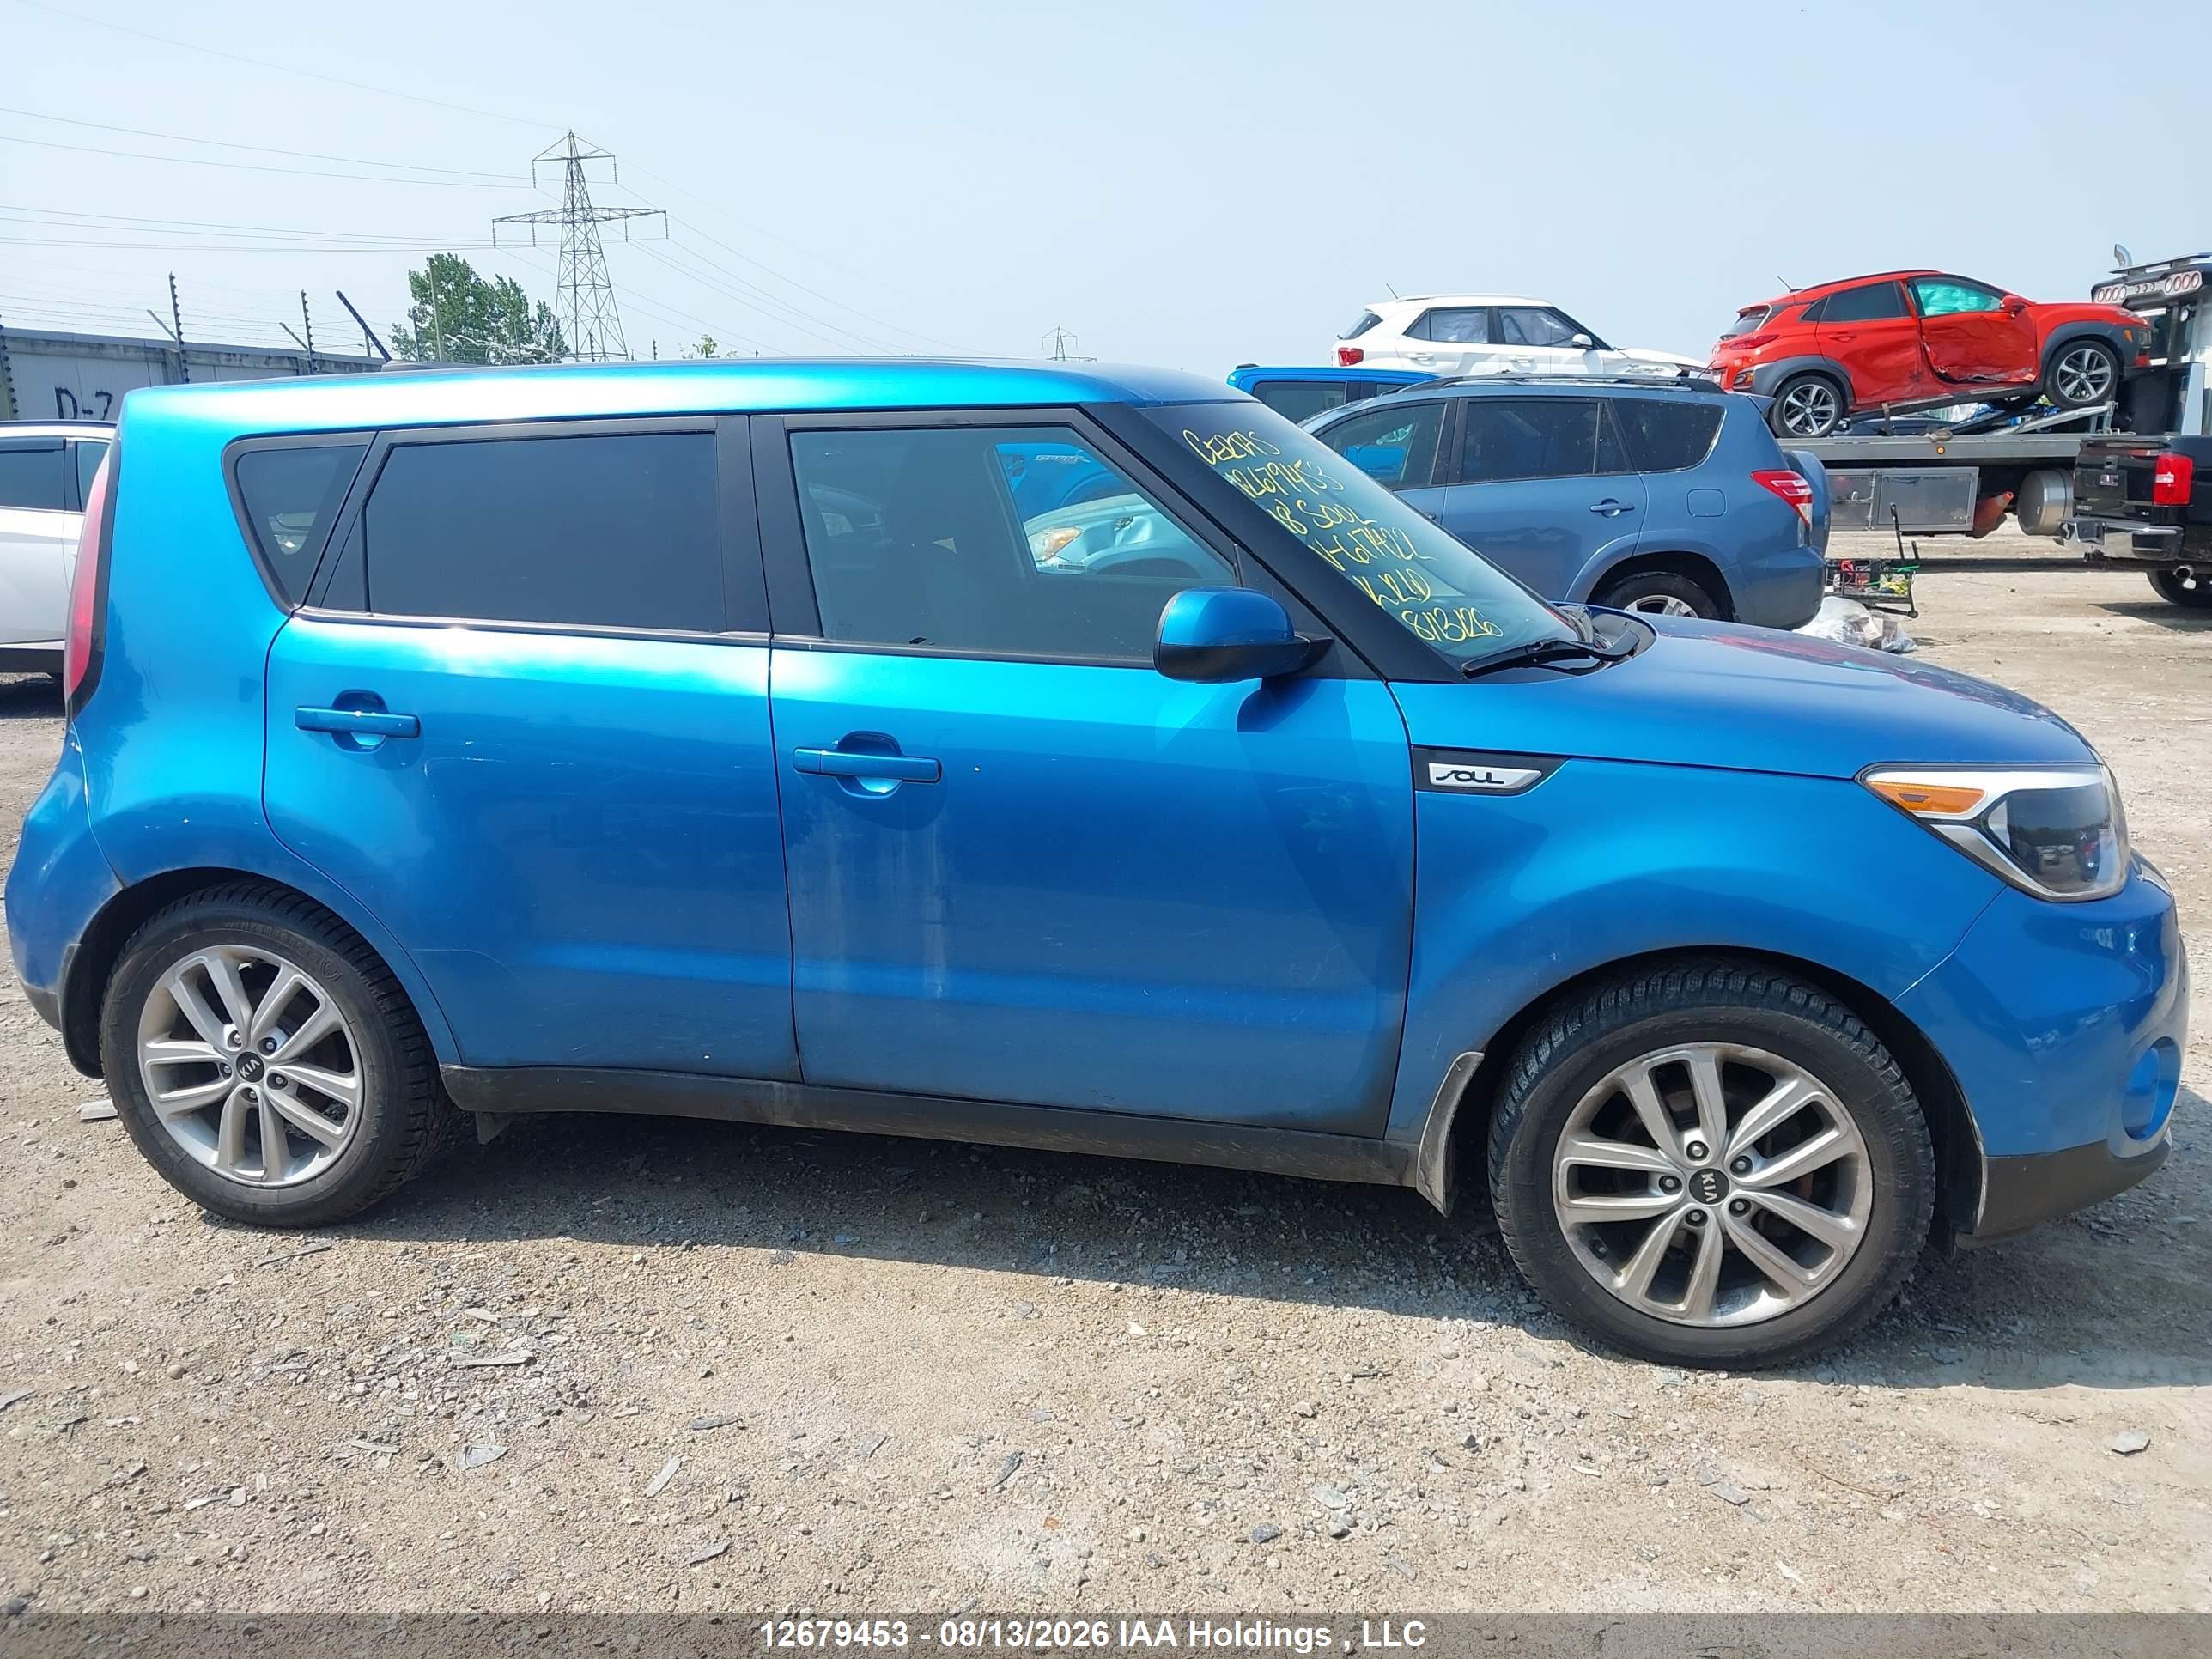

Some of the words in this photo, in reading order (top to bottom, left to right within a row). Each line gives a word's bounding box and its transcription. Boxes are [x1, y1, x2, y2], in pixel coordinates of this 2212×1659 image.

[1223, 459, 1344, 499] 12679453
[1267, 498, 1308, 535] 18
[1297, 499, 1376, 529] SOUL
[1435, 770, 1505, 785] SOUL
[240, 1058, 261, 1079] KIA
[1701, 1172, 1718, 1203] KIA
